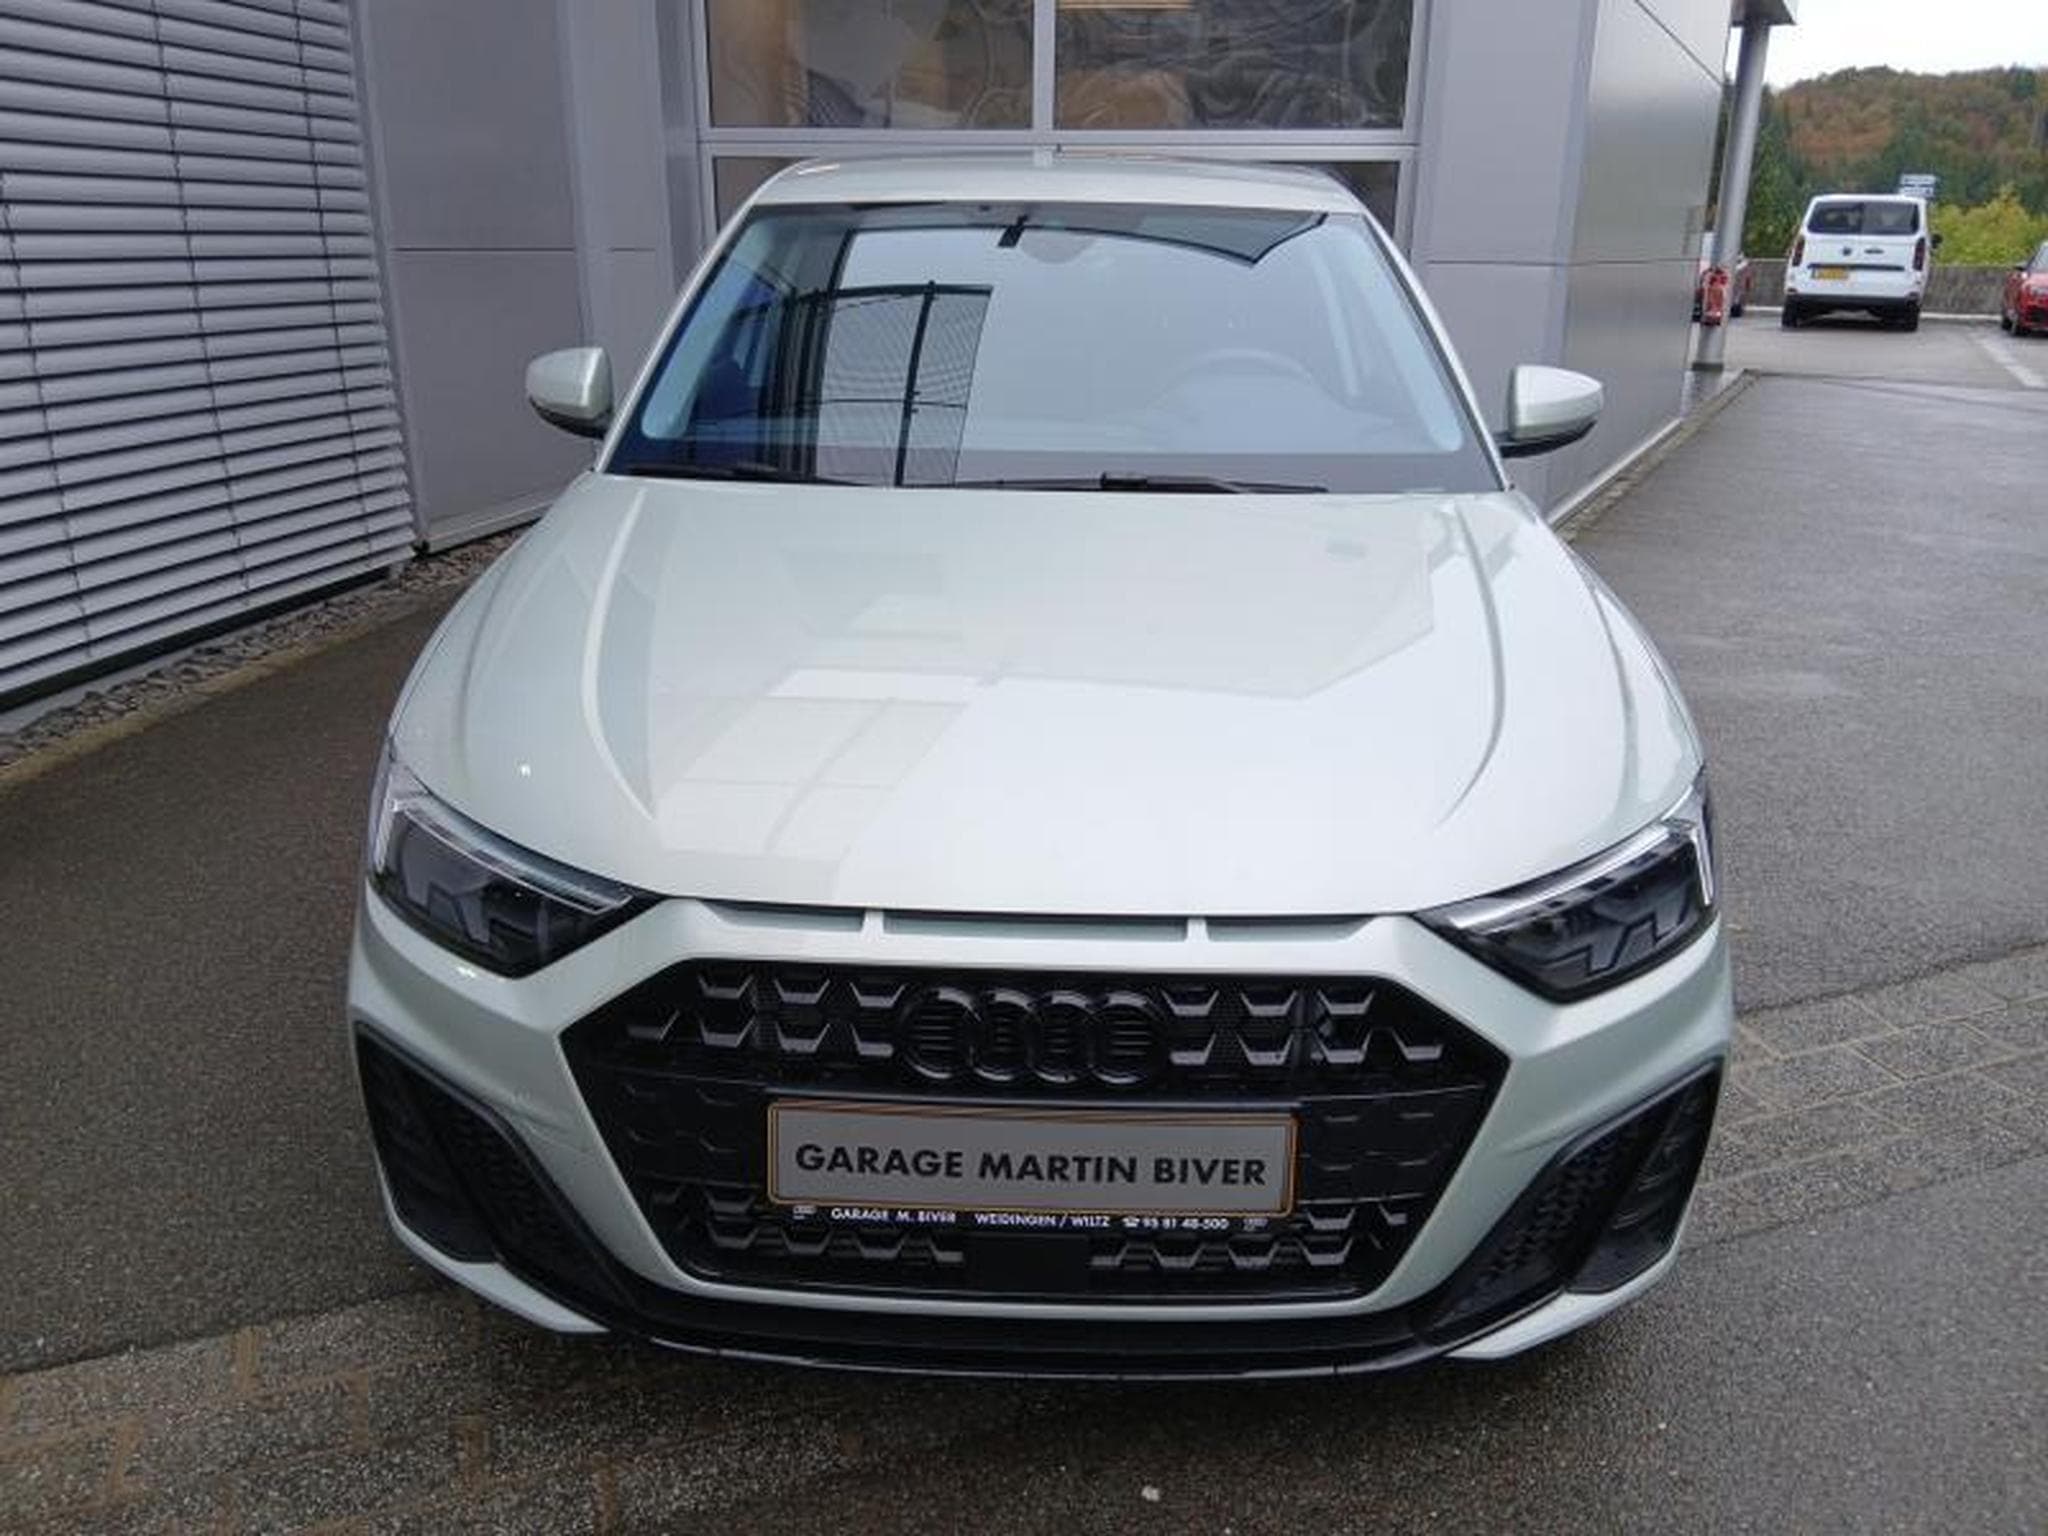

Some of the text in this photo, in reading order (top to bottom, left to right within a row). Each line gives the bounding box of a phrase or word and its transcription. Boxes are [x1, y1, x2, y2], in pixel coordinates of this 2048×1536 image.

[796, 1143, 1266, 1186] GARAGE MARTIN BIVER
[830, 1207, 889, 1222] GARAGE
[917, 1210, 957, 1223] BIVER
[974, 1209, 1056, 1225] WEIDINGEN
[1071, 1214, 1111, 1228] WILTZ
